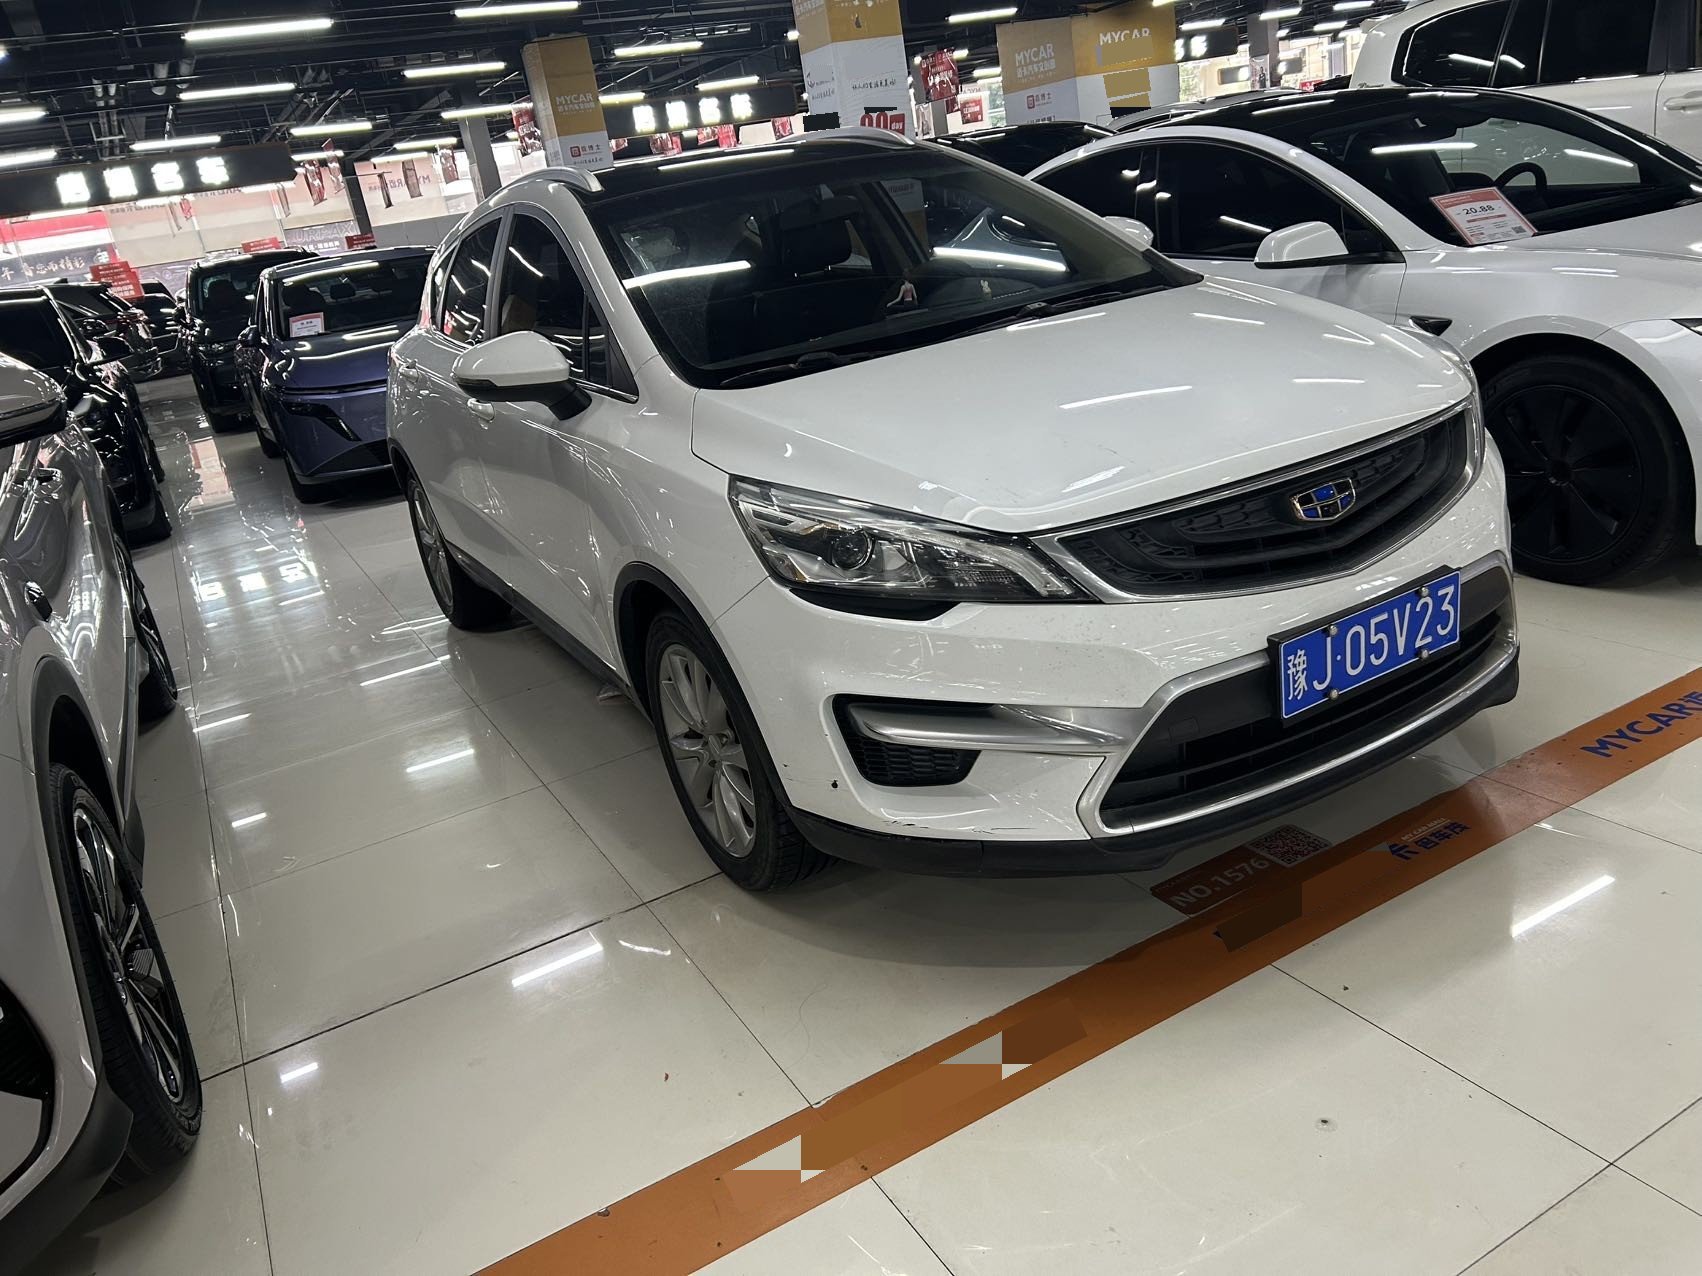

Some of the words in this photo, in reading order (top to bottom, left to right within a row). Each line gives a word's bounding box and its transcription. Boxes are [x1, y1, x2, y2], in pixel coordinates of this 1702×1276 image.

[1015, 43, 1055, 67] MYCAR
[555, 92, 594, 106] MYCAR
[1462, 204, 1496, 215] 20.88
[1286, 584, 1456, 702] 豫J·05V23
[1170, 856, 1271, 908] NO.1576
